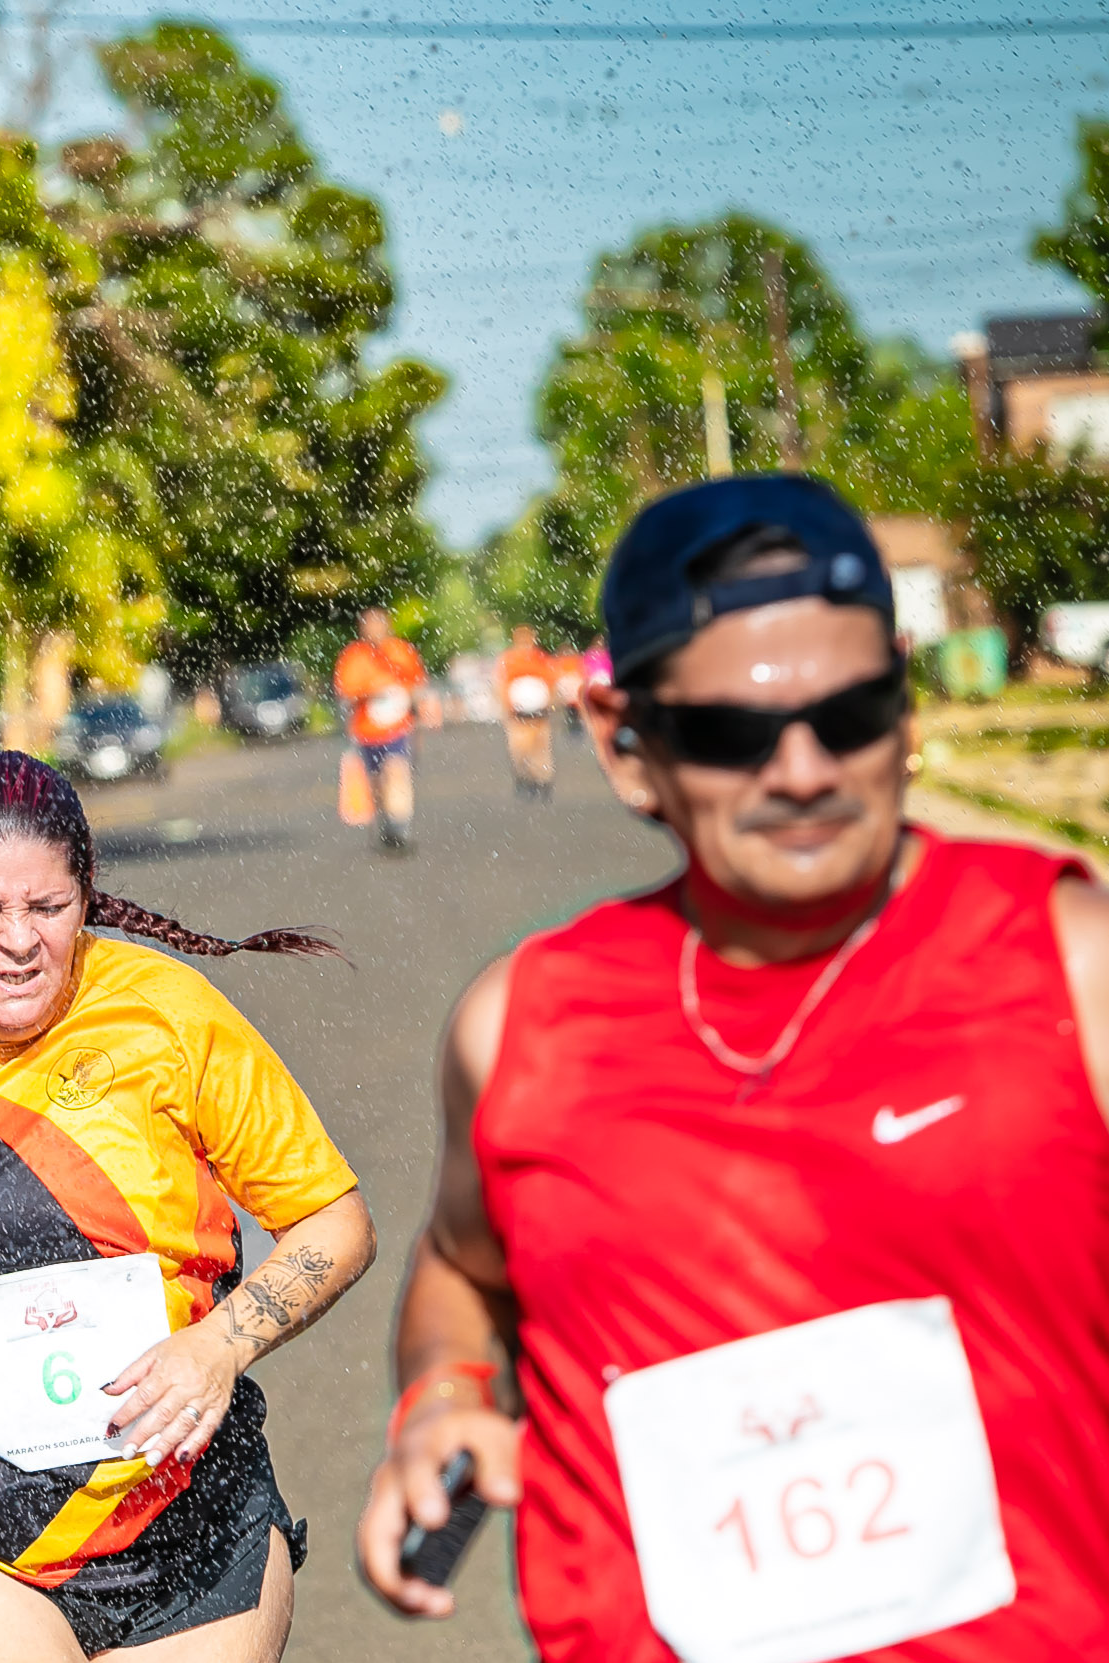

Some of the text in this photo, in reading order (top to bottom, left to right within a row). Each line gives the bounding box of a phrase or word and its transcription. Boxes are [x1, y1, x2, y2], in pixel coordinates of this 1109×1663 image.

[42, 1350, 82, 1405] 6
[6, 1443, 51, 1456] MARATON
[53, 1435, 101, 1449] SOLIDARIA
[714, 1459, 910, 1572] 162
